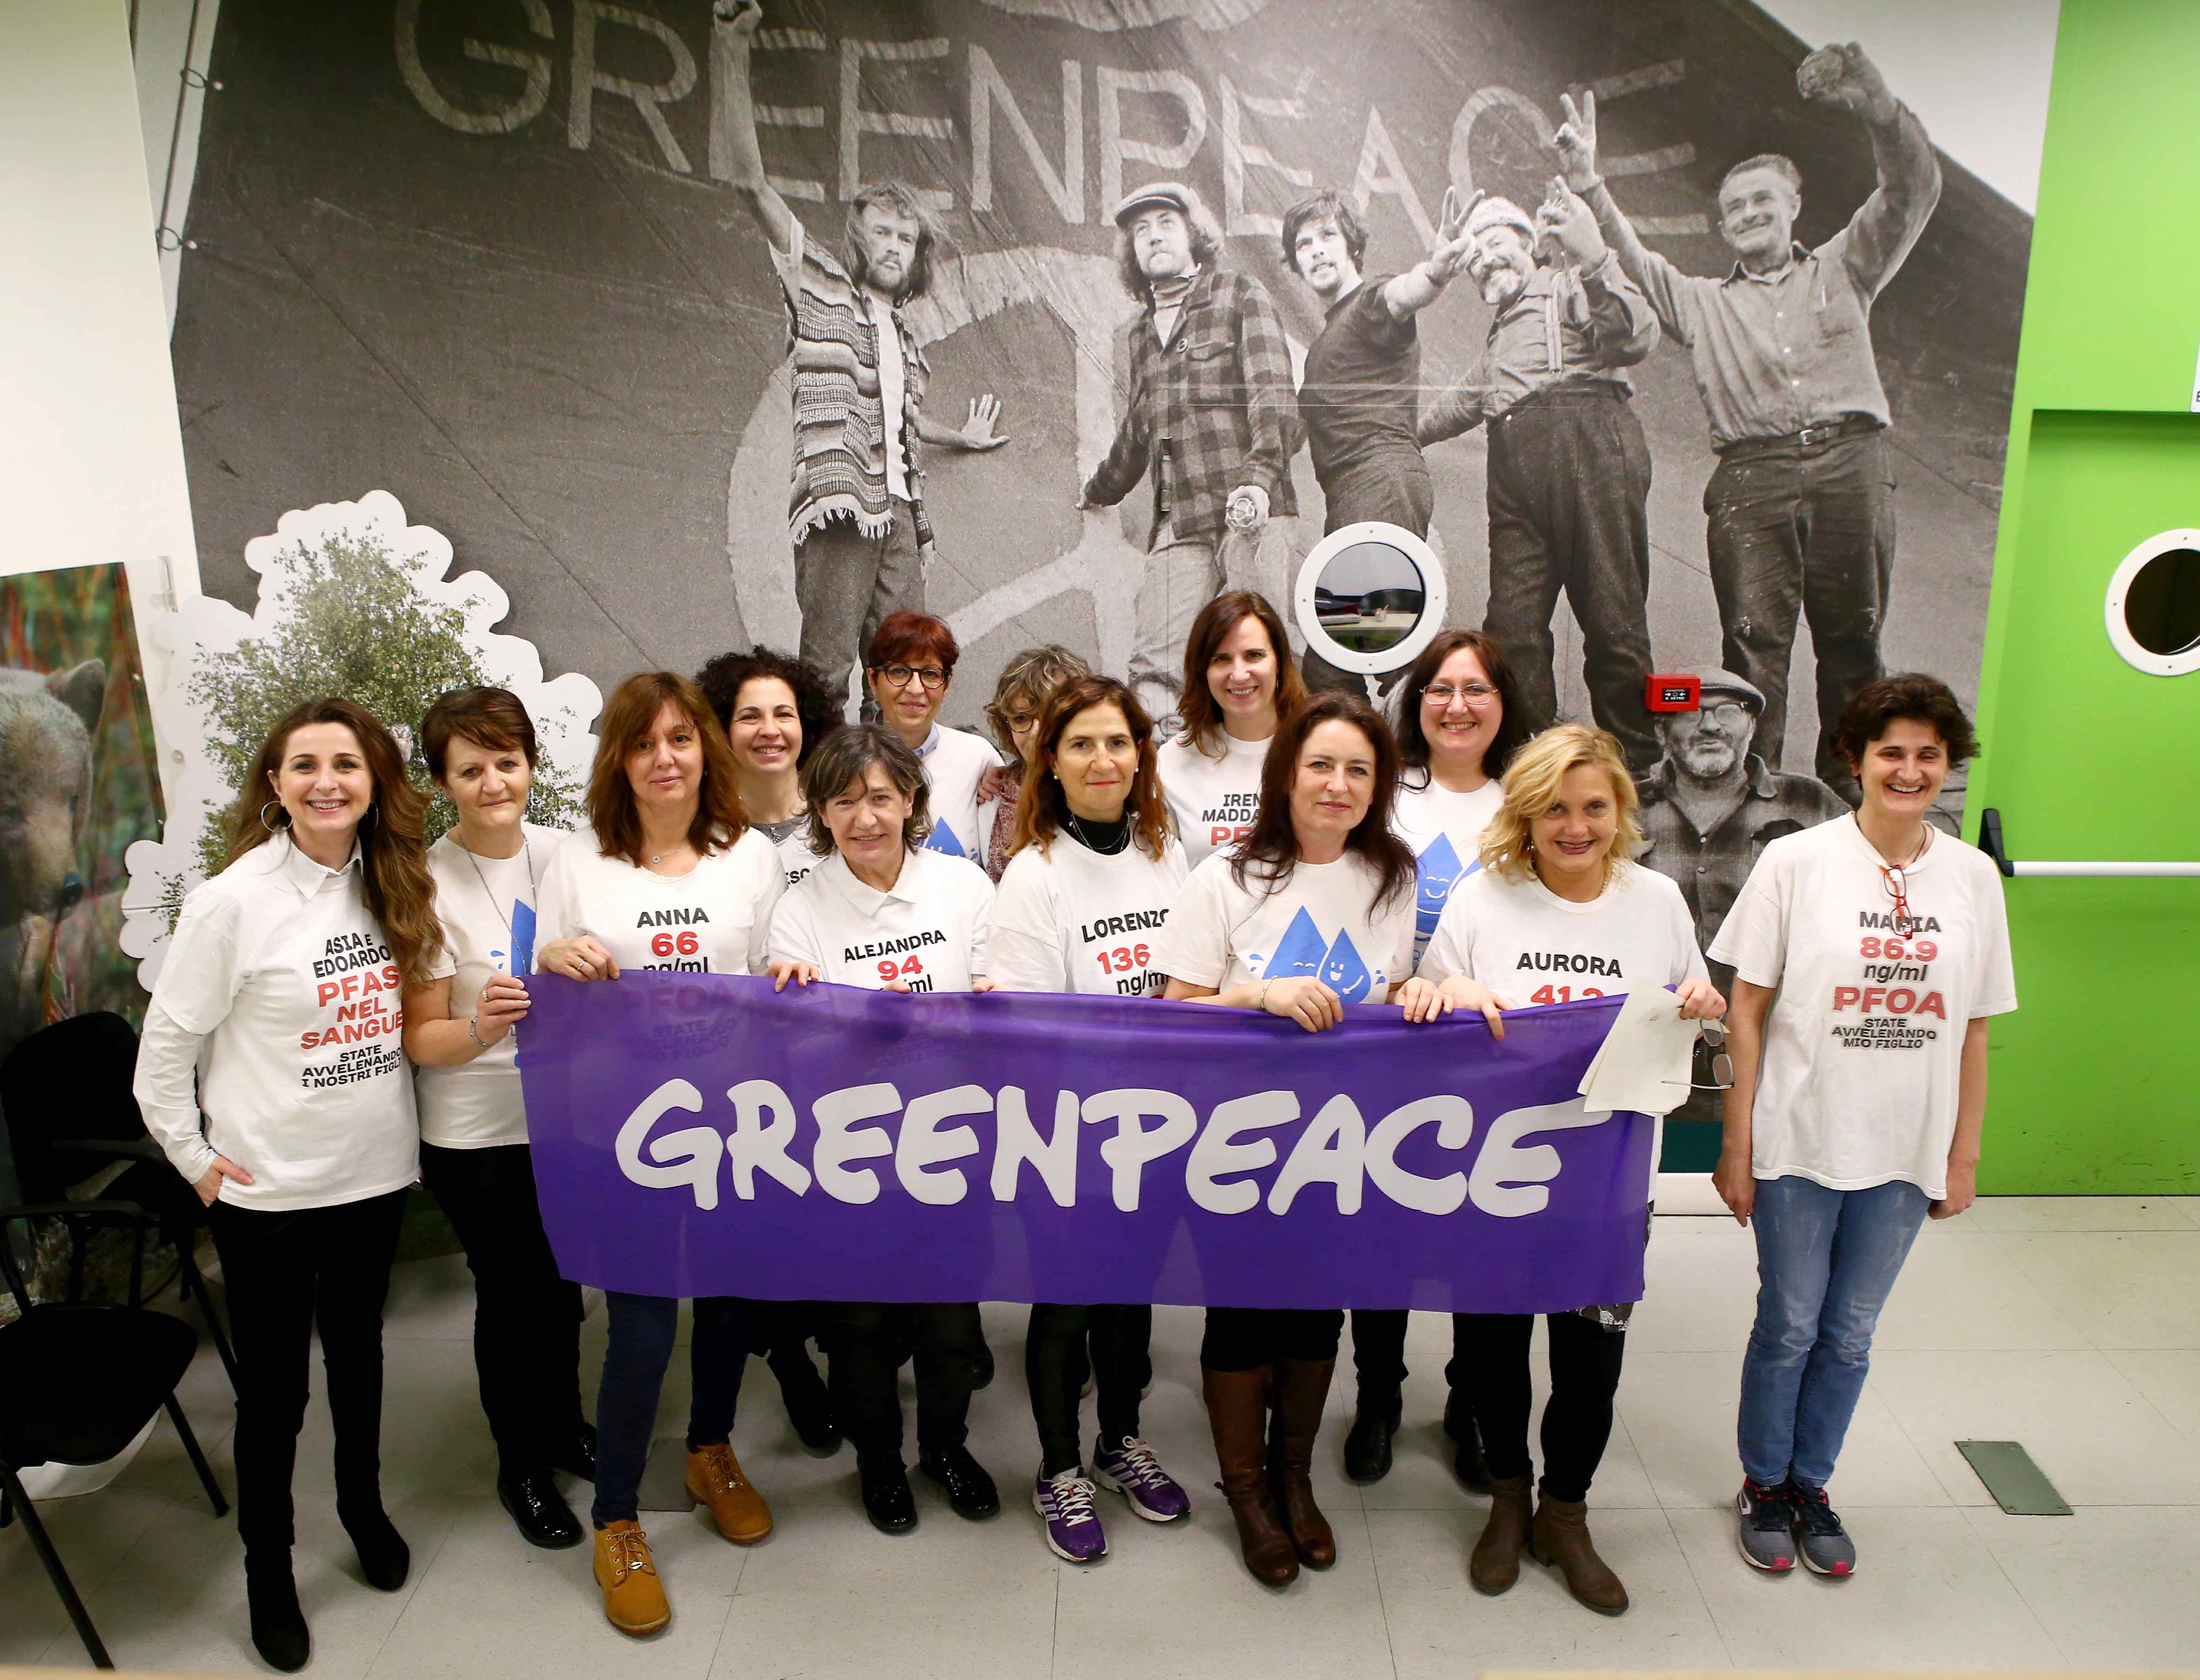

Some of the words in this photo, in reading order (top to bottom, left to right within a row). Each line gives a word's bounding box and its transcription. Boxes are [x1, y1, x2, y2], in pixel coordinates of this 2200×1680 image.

[636, 908, 710, 928] ANNA
[325, 932, 363, 956] ASIA
[364, 934, 373, 946] E
[651, 931, 699, 957] 66
[844, 930, 946, 963] ALEJANDRA
[1860, 937, 1938, 962] 86.9
[313, 945, 391, 978] EDOARDO
[877, 955, 923, 981] 94
[1096, 944, 1151, 974] 136
[1516, 952, 1623, 978] AURORA
[317, 965, 400, 1007] PFAS
[1863, 962, 1928, 984] ng/ml
[337, 997, 387, 1022] NEL
[1833, 987, 1946, 1020] PFOA
[300, 1010, 403, 1050] SANGUE
[1831, 1027, 1937, 1039] AVVELENANDO
[1864, 1018, 1907, 1027] STATE
[339, 1044, 382, 1063] STATE
[1843, 1038, 1872, 1047] MIO
[1875, 1039, 1923, 1048] FIGLIO
[302, 1047, 401, 1077] AVVELENANDO
[302, 1079, 309, 1087] I
[314, 1069, 371, 1088] NOSTRI
[615, 1077, 1612, 1218] GREENPEACE
